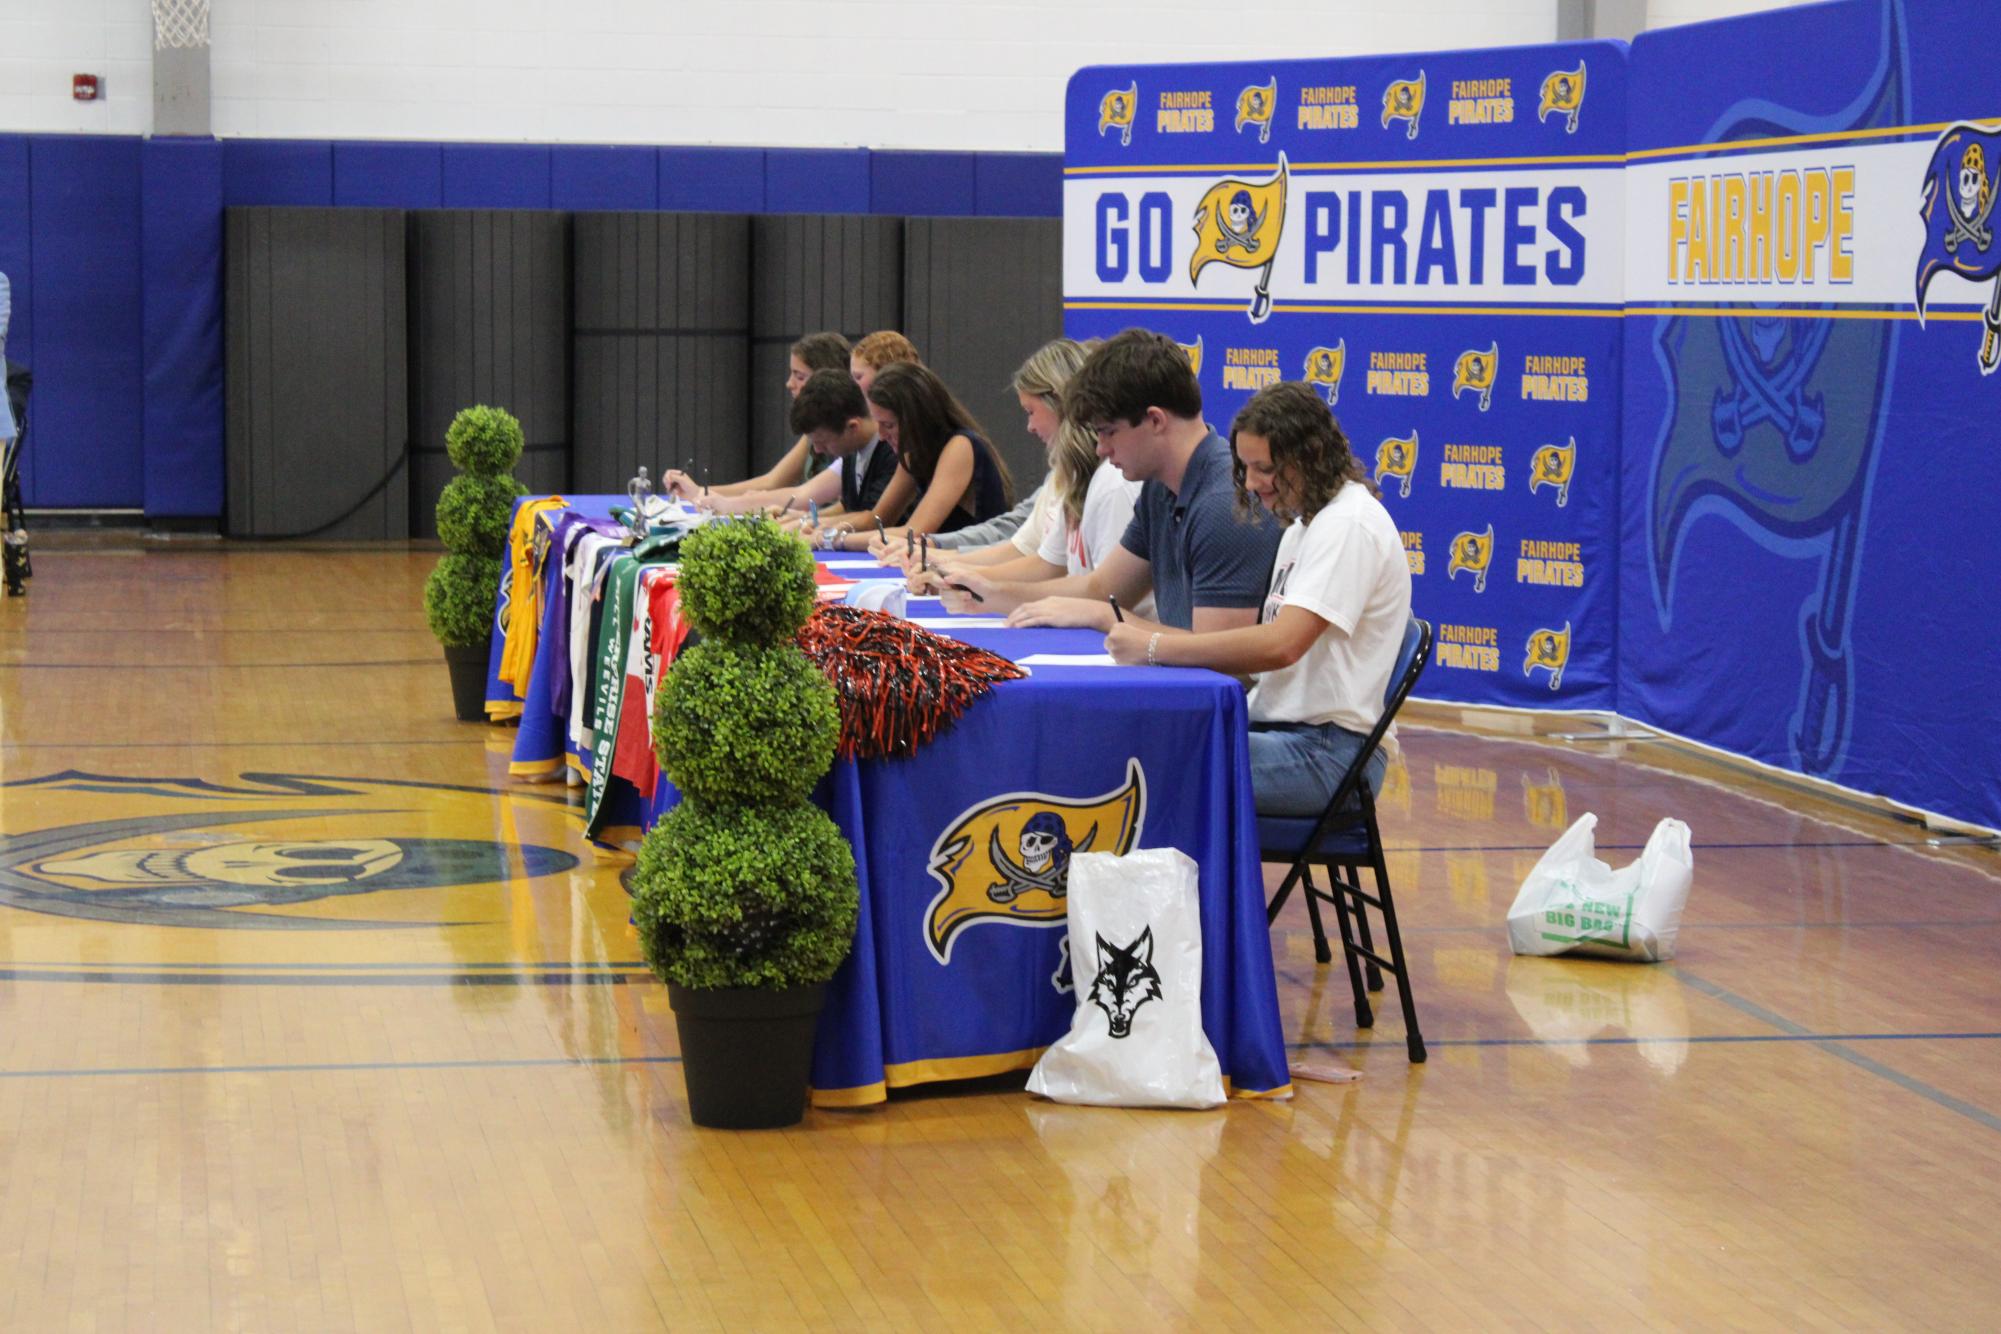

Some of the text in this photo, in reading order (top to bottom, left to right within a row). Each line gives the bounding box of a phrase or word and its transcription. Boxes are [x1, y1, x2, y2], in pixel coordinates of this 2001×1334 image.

[1302, 86, 1356, 105] FAIRHOPE
[1453, 79, 1510, 98] FAIRHOPE
[1160, 92, 1211, 109] FAIRHOPE
[1449, 96, 1513, 123] PIRATES
[1158, 107, 1213, 131] PIRATES
[1299, 103, 1358, 128] PIRATES
[1096, 186, 1587, 286] GO PIRATES
[1668, 165, 1855, 285] FAIRHOPE
[1226, 348, 1278, 367] FAIRHOPE
[1371, 352, 1426, 371] FAIRHOPE
[1526, 356, 1584, 375] FAIRHOPE
[1368, 369, 1428, 395] PIRATES
[1522, 373, 1587, 400] PIRATES
[1445, 445, 1502, 464] FAIRHOPE
[1442, 462, 1504, 489] PIRATES
[1521, 540, 1580, 560] FAIRHOPE
[1518, 558, 1583, 586] PIRATES
[1440, 624, 1496, 644] FAIRHOPE
[1437, 642, 1499, 671] PIRATES
[1546, 911, 1576, 928] BIG
